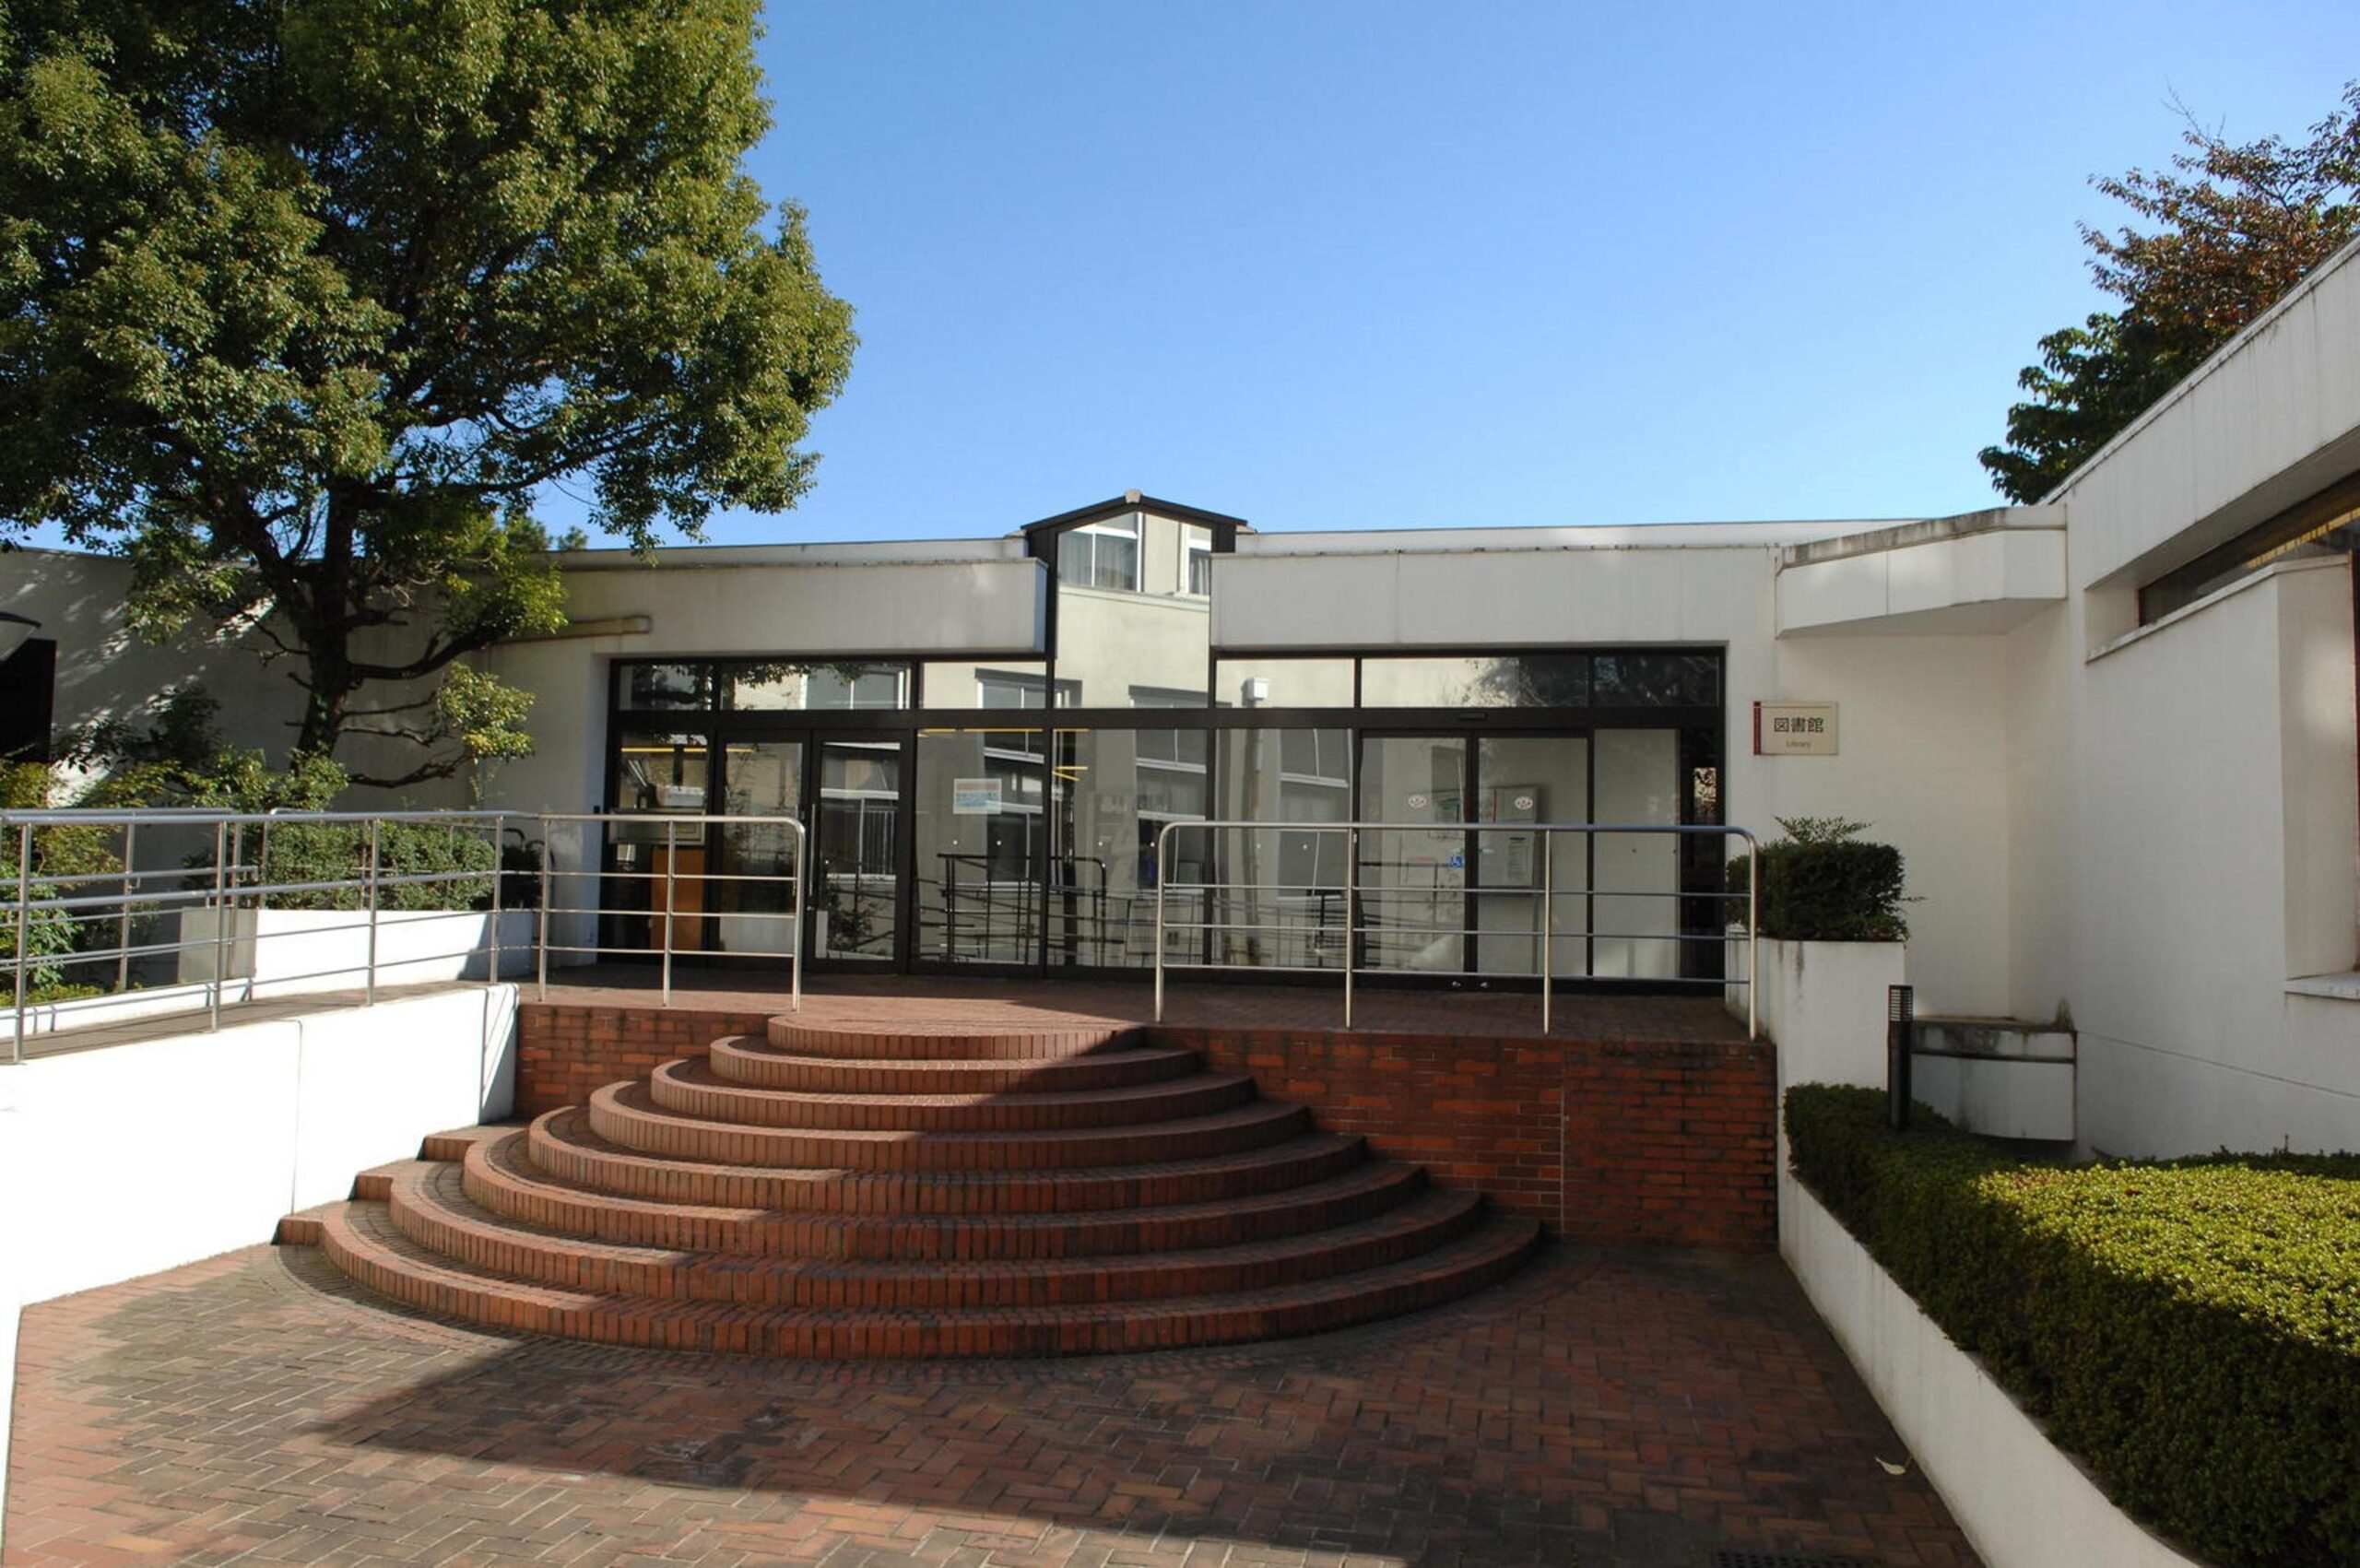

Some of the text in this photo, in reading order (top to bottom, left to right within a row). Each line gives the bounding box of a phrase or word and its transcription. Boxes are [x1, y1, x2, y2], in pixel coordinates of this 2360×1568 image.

[1774, 717, 1823, 733] 図書館
[1786, 740, 1811, 749] Library
